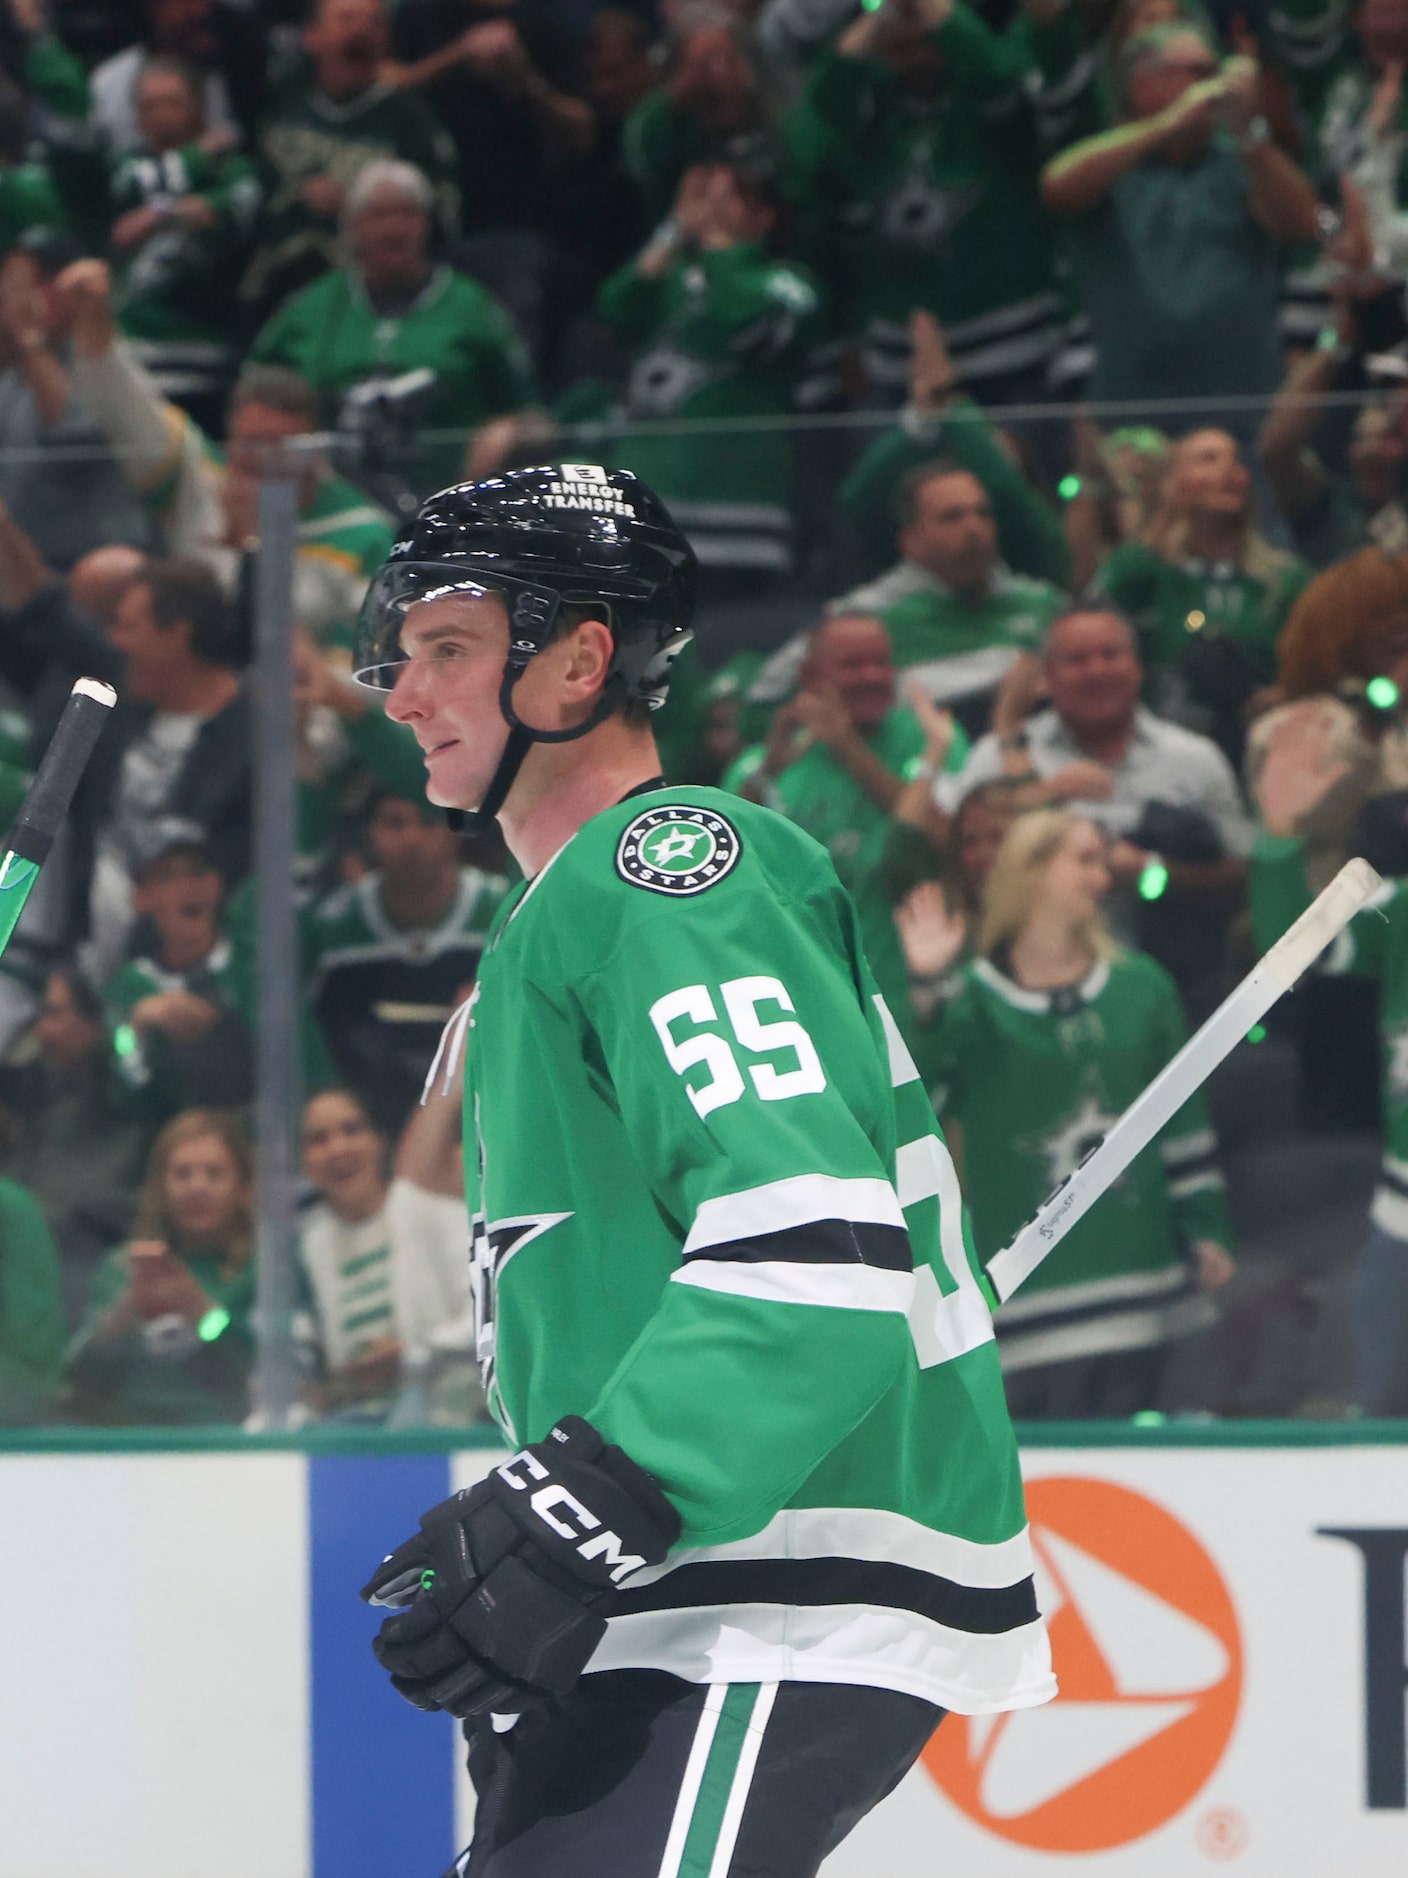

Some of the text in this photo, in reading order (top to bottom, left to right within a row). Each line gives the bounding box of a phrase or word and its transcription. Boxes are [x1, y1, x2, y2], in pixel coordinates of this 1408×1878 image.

[542, 494, 636, 518] TRANSFER
[549, 481, 625, 501] ENERGY
[624, 811, 722, 858] DALLAS
[639, 850, 730, 886] STARS
[648, 976, 827, 1122] 55
[496, 1450, 647, 1583] CCM
